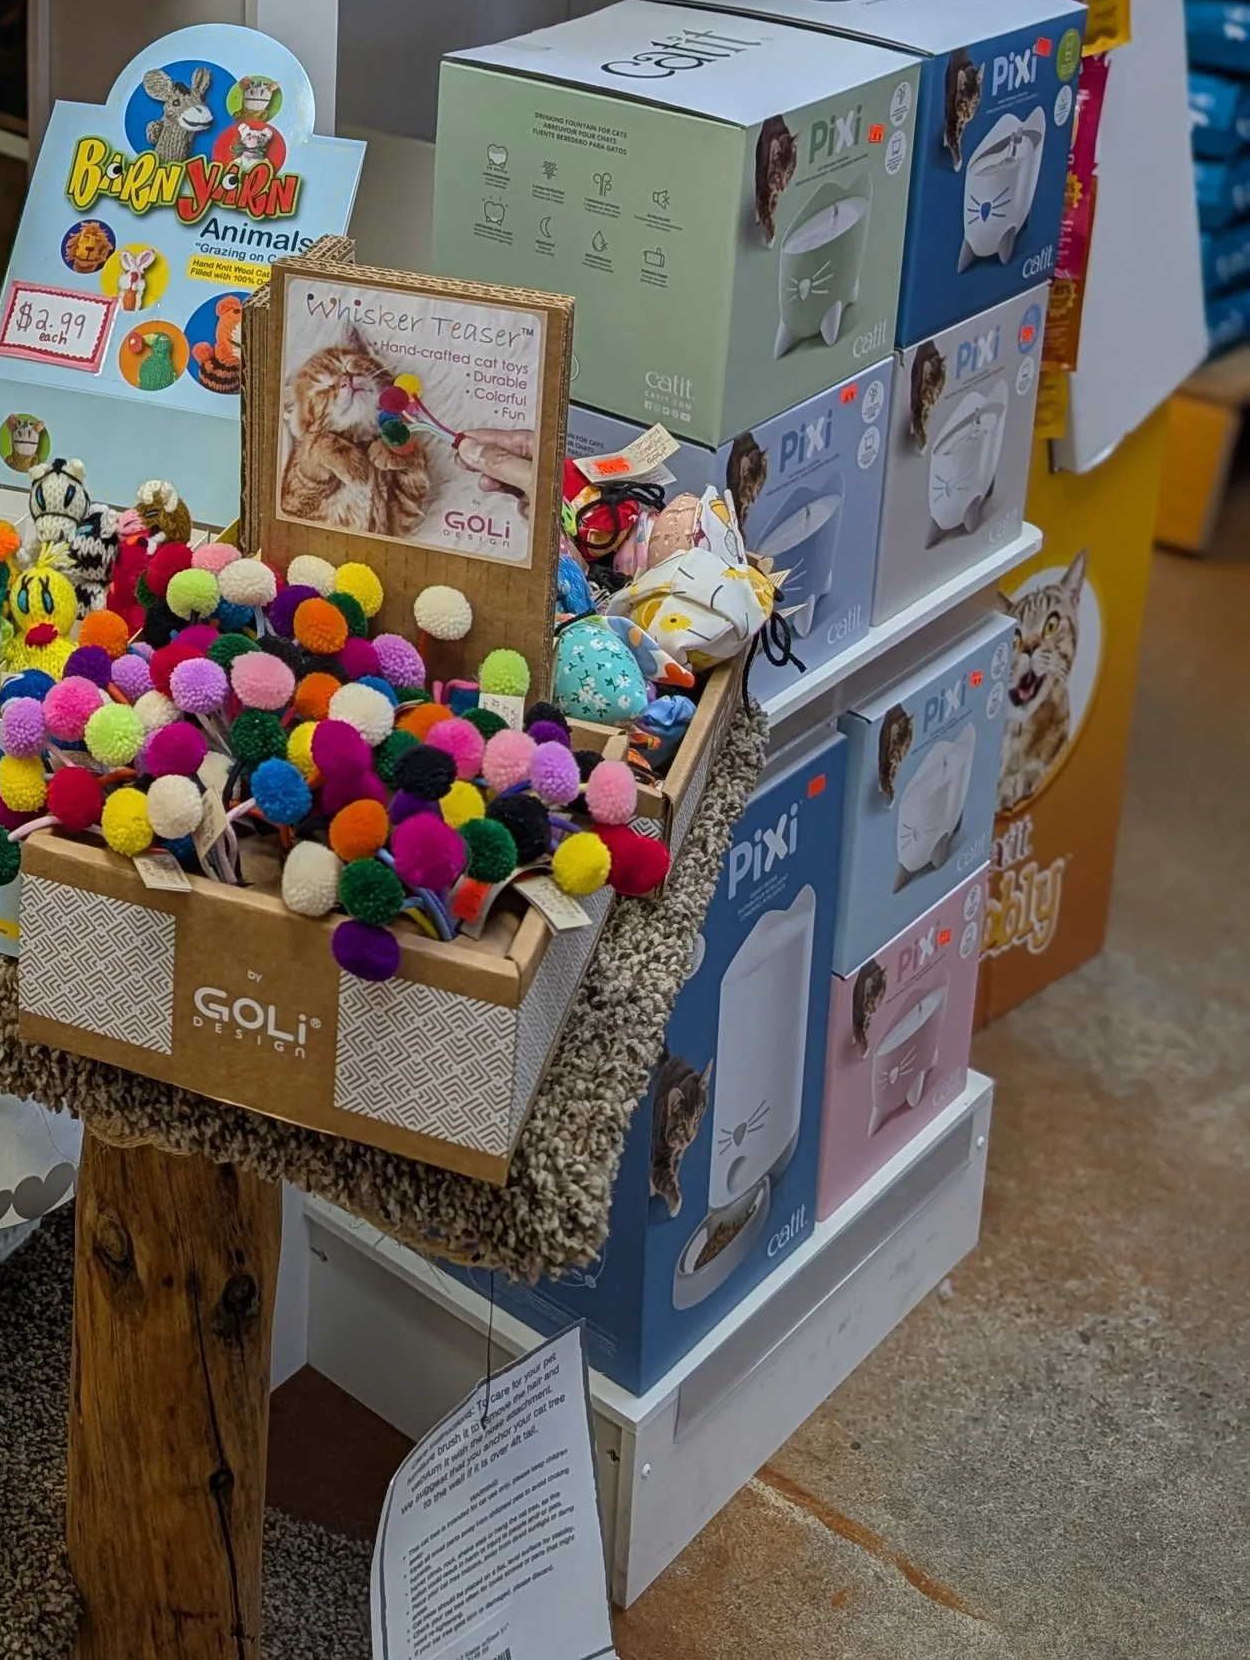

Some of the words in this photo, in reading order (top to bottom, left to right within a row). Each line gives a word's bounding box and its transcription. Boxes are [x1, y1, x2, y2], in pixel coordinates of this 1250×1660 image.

[192, 260, 214, 268] Hand
[215, 263, 233, 271] Knit
[234, 265, 254, 275] Wool
[249, 253, 264, 262] on
[191, 268, 212, 277] Filled
[214, 271, 231, 280] with
[234, 275, 255, 284] 100%
[16, 300, 87, 339] $2.99
[306, 292, 424, 333] Whisker
[38, 329, 68, 345] each
[380, 340, 472, 365] Hand-crafted
[474, 354, 499, 369] cat
[501, 358, 529, 375] toys
[473, 370, 528, 390] Durable
[474, 387, 527, 407] Colorful
[501, 407, 526, 421] Fun
[247, 969, 263, 983] by
[490, 1386, 510, 1403] care
[543, 1352, 557, 1368] pet
[437, 1433, 462, 1456] brush
